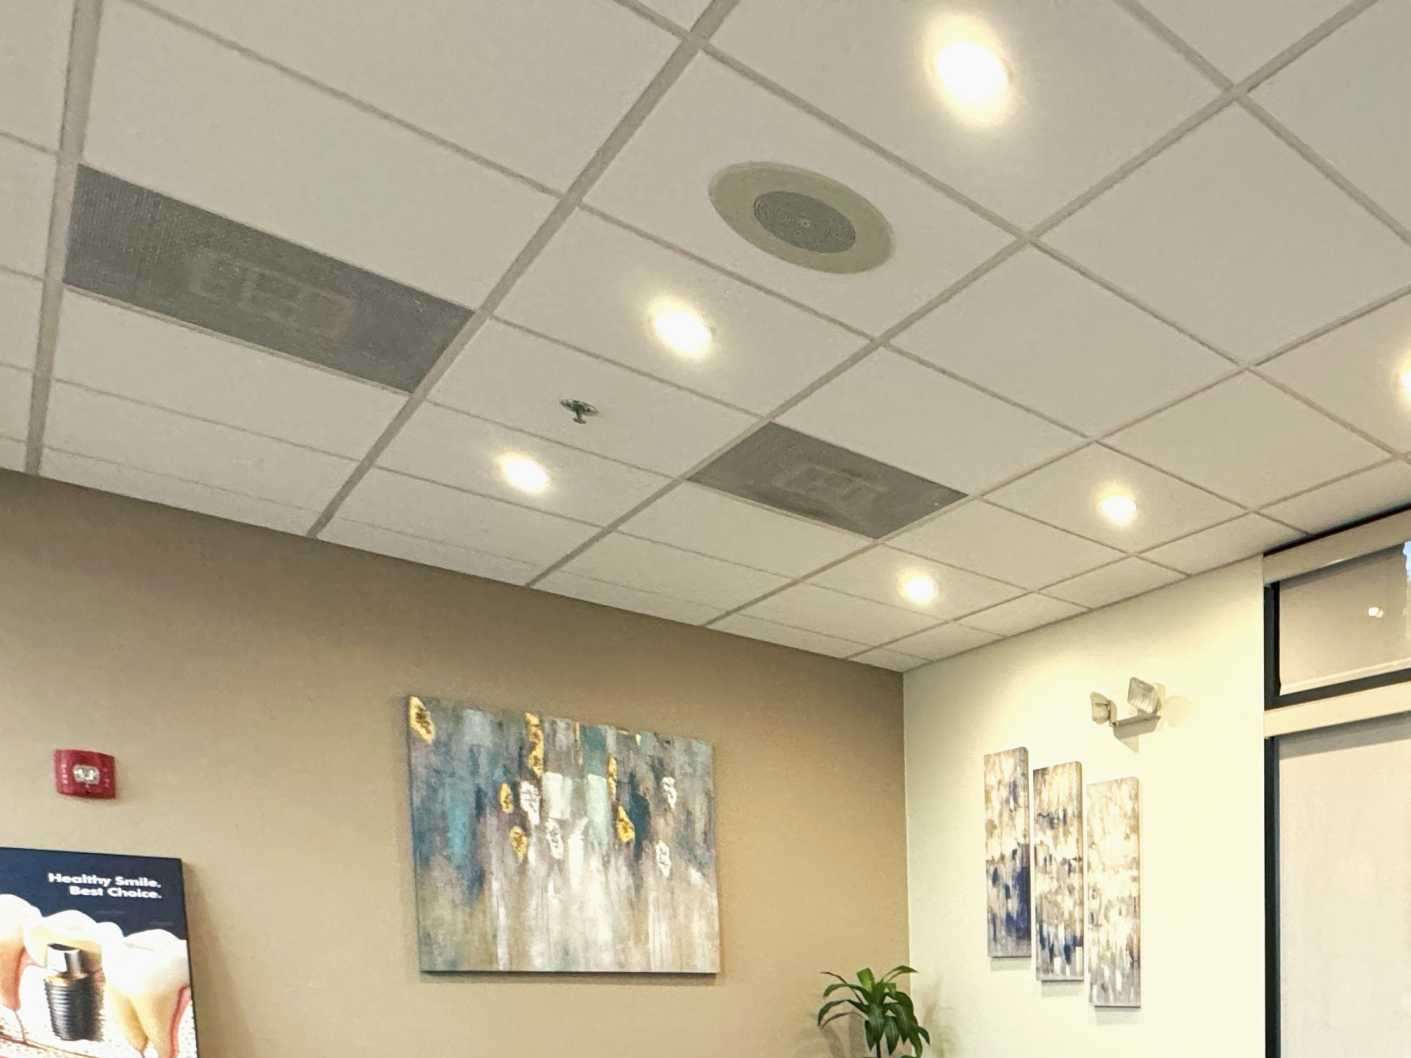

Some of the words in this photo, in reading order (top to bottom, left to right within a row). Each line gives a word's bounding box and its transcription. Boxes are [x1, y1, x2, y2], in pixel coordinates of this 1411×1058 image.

[48, 872, 112, 888] Healthy
[115, 876, 162, 889] Smile.
[69, 885, 104, 897] Best
[107, 886, 162, 899] Choice.
